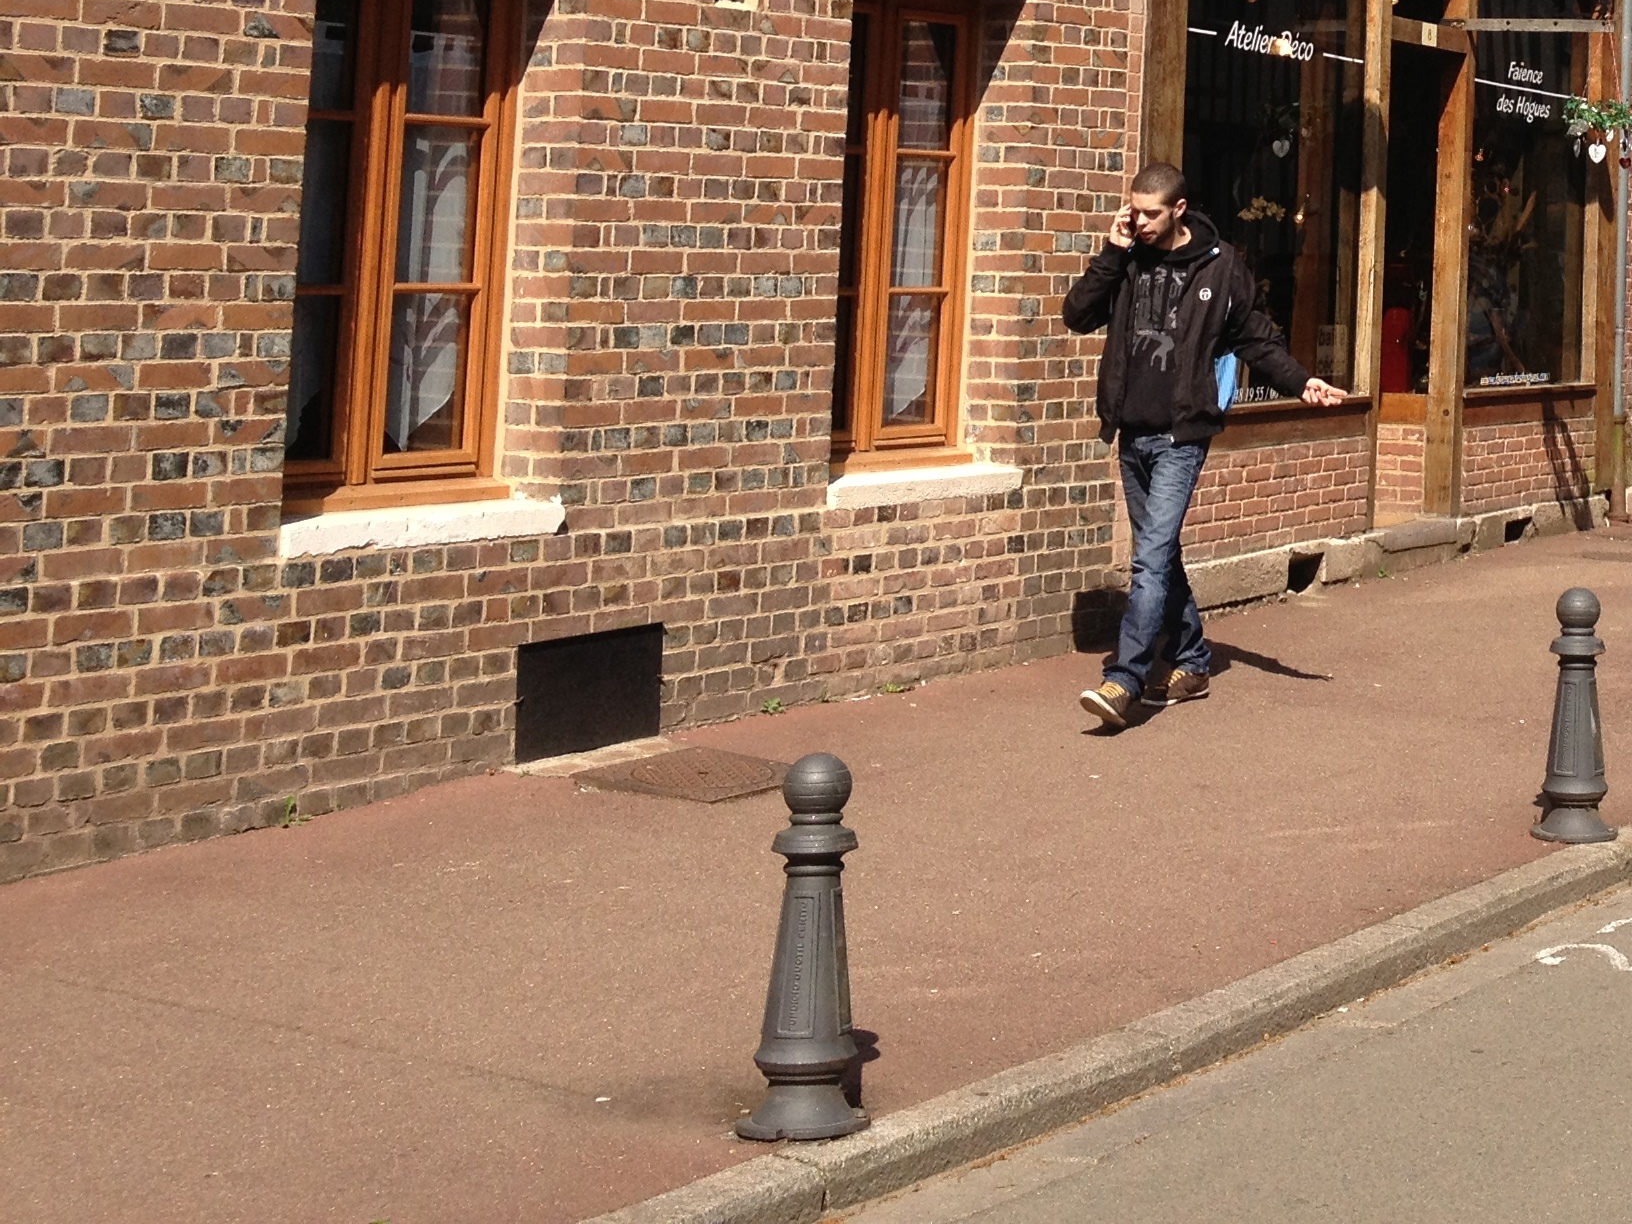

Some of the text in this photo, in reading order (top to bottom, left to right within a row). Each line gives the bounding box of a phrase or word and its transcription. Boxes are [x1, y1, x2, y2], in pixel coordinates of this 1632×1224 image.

[1224, 19, 1277, 54] Atelier
[1496, 94, 1551, 123] des Hogues
